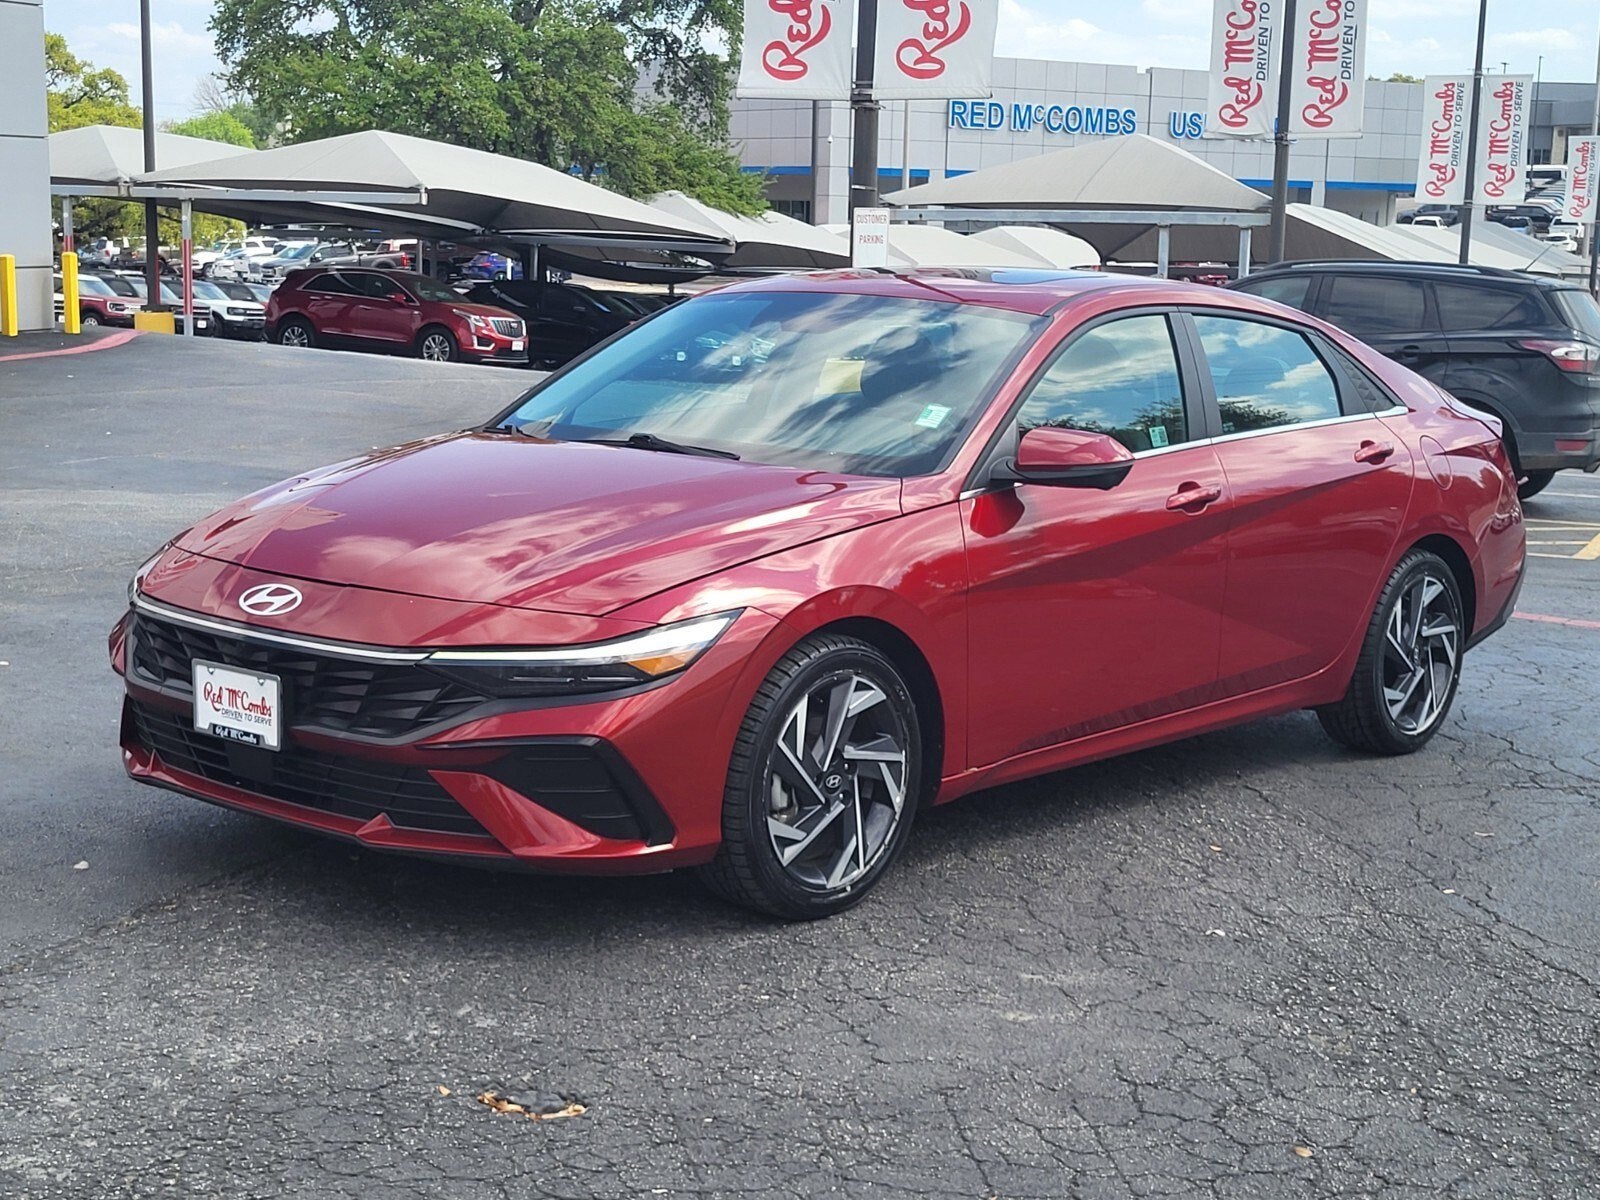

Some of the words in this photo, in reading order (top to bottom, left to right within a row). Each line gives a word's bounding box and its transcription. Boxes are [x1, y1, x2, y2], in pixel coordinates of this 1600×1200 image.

[1259, 2, 1270, 22] TO
[1344, 0, 1355, 20] TO
[1256, 27, 1269, 81] DRIVEN
[1341, 25, 1354, 80] DRIVEN
[1219, 76, 1263, 128] Red
[1302, 76, 1348, 128] Red
[1457, 82, 1465, 112] SERVE
[1515, 81, 1524, 111] SERVE
[950, 100, 1004, 129] RED
[1012, 103, 1137, 135] McCOMBS
[1172, 111, 1206, 138] US
[1430, 82, 1456, 160] McCombs
[1454, 115, 1462, 127] TO
[1488, 81, 1515, 160] McCombs
[1513, 115, 1521, 127] TO
[1450, 131, 1461, 167] DRIVEN
[1510, 130, 1520, 167] DRIVEN
[1425, 163, 1456, 197] Red
[1484, 163, 1515, 198] Red
[1572, 141, 1590, 192] McCombs
[856, 214, 887, 224] CUSTOMER
[1568, 195, 1590, 218] Red
[859, 234, 884, 244] PARKING
[204, 681, 223, 712] Red
[225, 687, 272, 718] McCombs
[215, 725, 228, 738] Red
[221, 707, 243, 720] DRIVEN
[244, 713, 253, 722] TO
[253, 715, 272, 727] SERVE
